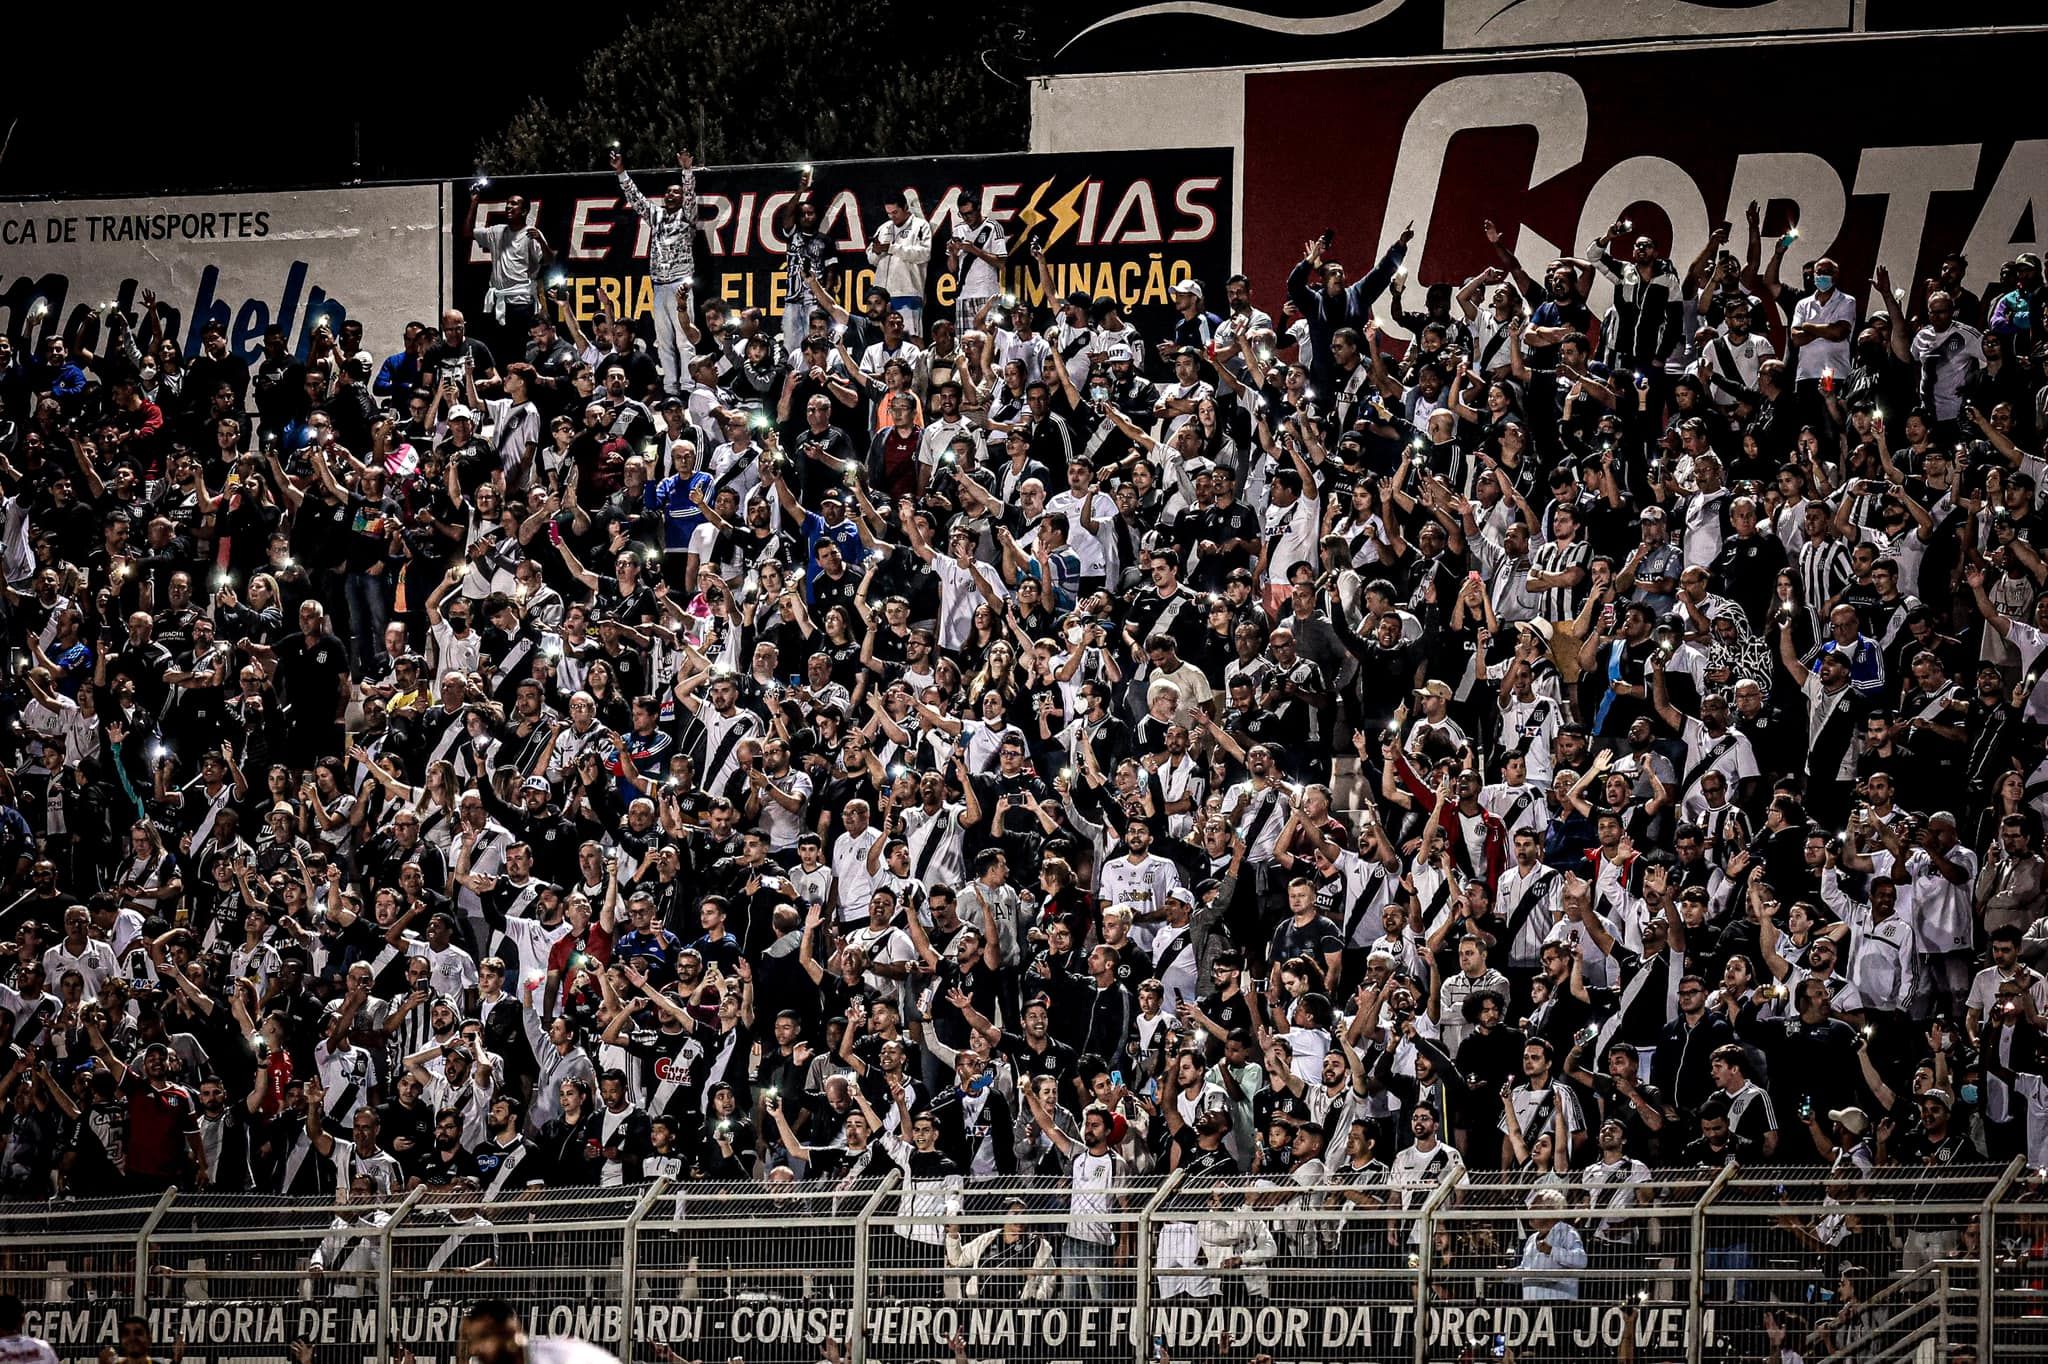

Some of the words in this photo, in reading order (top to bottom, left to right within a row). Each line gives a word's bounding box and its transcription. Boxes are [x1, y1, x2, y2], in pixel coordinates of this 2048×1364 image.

[47, 217, 78, 244] DE
[86, 211, 270, 242] TRANSPORTES
[936, 272, 958, 307] e
[96, 1308, 120, 1344] A
[298, 1307, 337, 1344] DE
[969, 1306, 1068, 1347] NATO
[1079, 1306, 1099, 1347] E
[1322, 1306, 1373, 1348] DA
